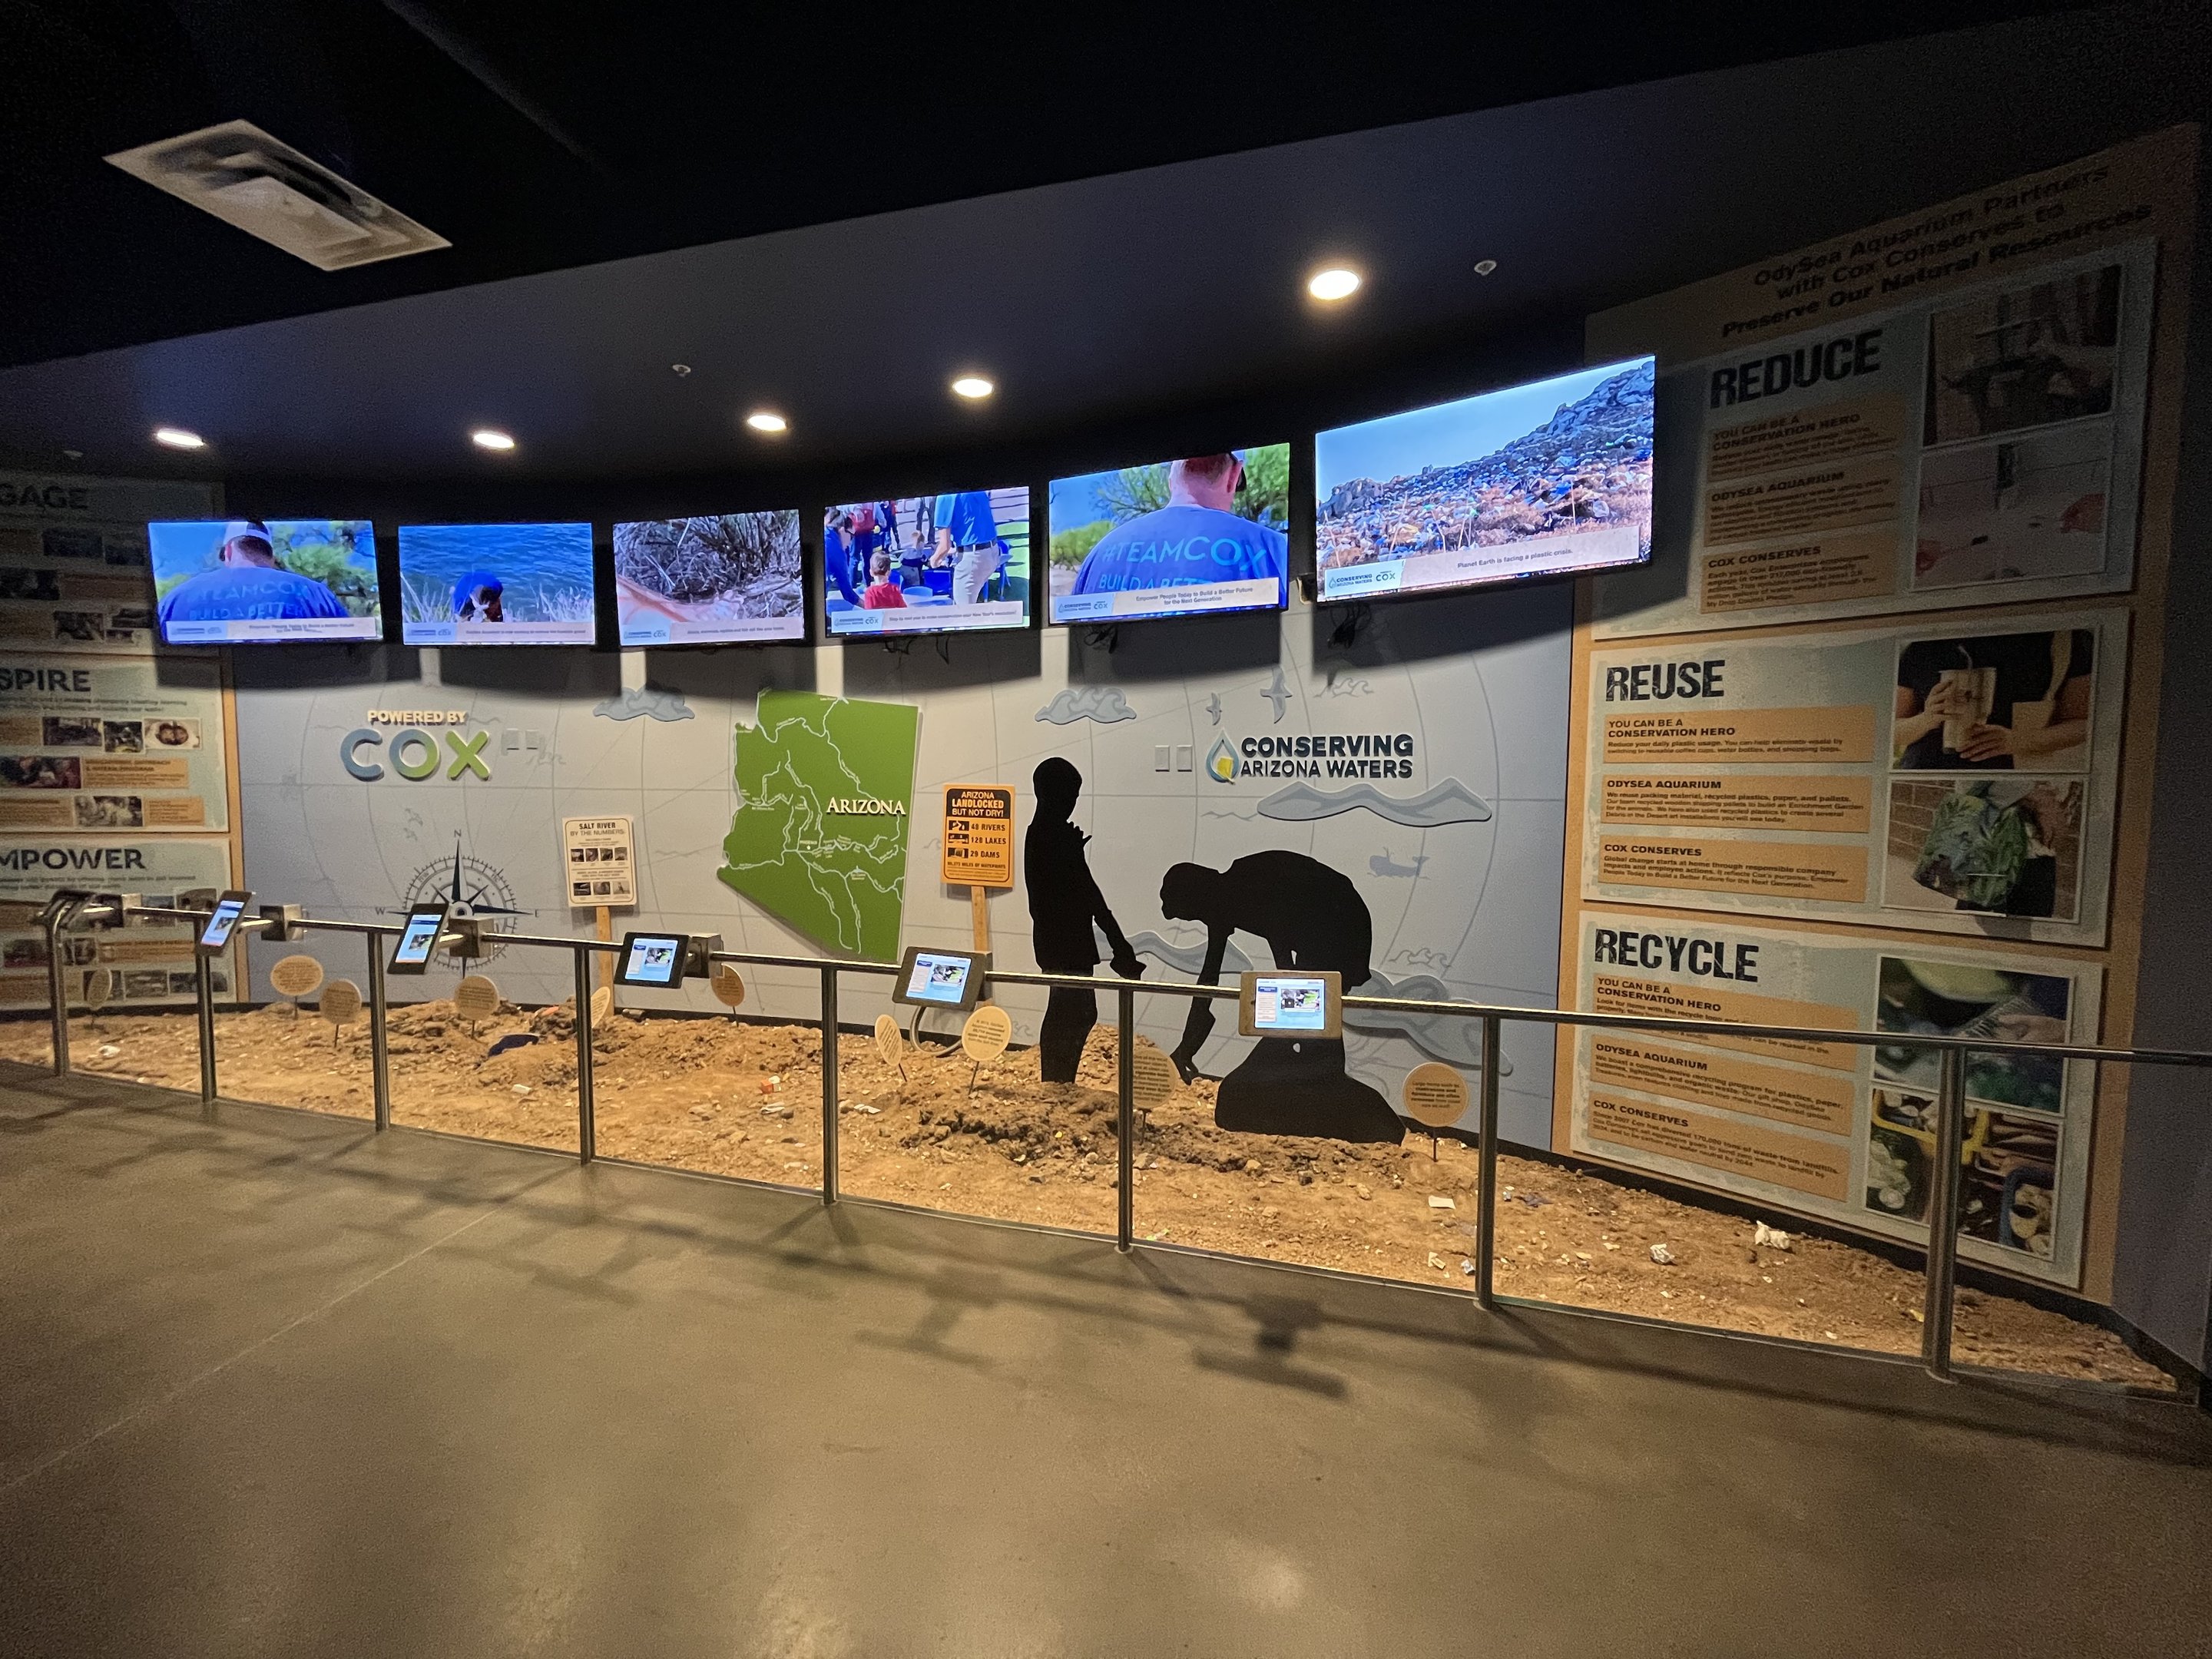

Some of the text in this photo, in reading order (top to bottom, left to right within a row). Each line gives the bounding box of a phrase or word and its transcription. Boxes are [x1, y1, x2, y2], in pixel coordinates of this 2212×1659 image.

[1754, 165, 2109, 285] OdySea Aquarium Partners
[1777, 275, 1825, 300] with
[1833, 261, 1876, 282] Cox
[1885, 214, 2025, 268] Conserves
[1723, 204, 2153, 337] Preserve Our Natural Resources
[1710, 328, 1883, 409] REDUCE
[1713, 423, 1816, 452] CONSERVATION
[1820, 413, 1860, 429] HERO
[1714, 415, 1799, 441] YOU CAN BE A
[1711, 472, 1845, 502] ODYSEA AQUARIUM
[1102, 536, 1267, 578] #TEAMCOX
[1531, 551, 1552, 560] plastic
[1708, 546, 1821, 568] COX CONSERVES
[1099, 574, 1141, 591] BUILD
[1336, 572, 1396, 583] CONSERVING COX
[0, 668, 91, 693] SPIRE
[1605, 660, 1726, 702] REUSE
[367, 710, 468, 724] POWERED BY
[1608, 727, 1735, 737] CONSERVATION HERO
[340, 728, 491, 781] COX
[1241, 734, 1413, 757] CONSERVING
[1240, 760, 1413, 778] ARIZONA WATERS
[826, 796, 906, 816] ARIZONA
[952, 799, 1004, 809] LANDLOCKED
[0, 849, 146, 870] MPOWER
[1631, 846, 1702, 856] CONSERVES
[1711, 862, 1743, 870] through
[1796, 868, 1837, 876] company
[1594, 929, 1759, 982] RECYCLE
[1598, 978, 1618, 987] YOU
[1622, 981, 1642, 990] CAN
[1646, 984, 1660, 992] BE
[1598, 987, 1721, 1012] CONSERVATION HERO
[1596, 1043, 1707, 1071] ODYSEA AQUARIUM
[1608, 1057, 1628, 1065] boast
[1636, 1064, 1690, 1078] comprehensive
[1692, 1075, 1727, 1087] recycling
[1728, 1082, 1762, 1092] program
[1594, 1100, 1689, 1127] COX CONSERVES
